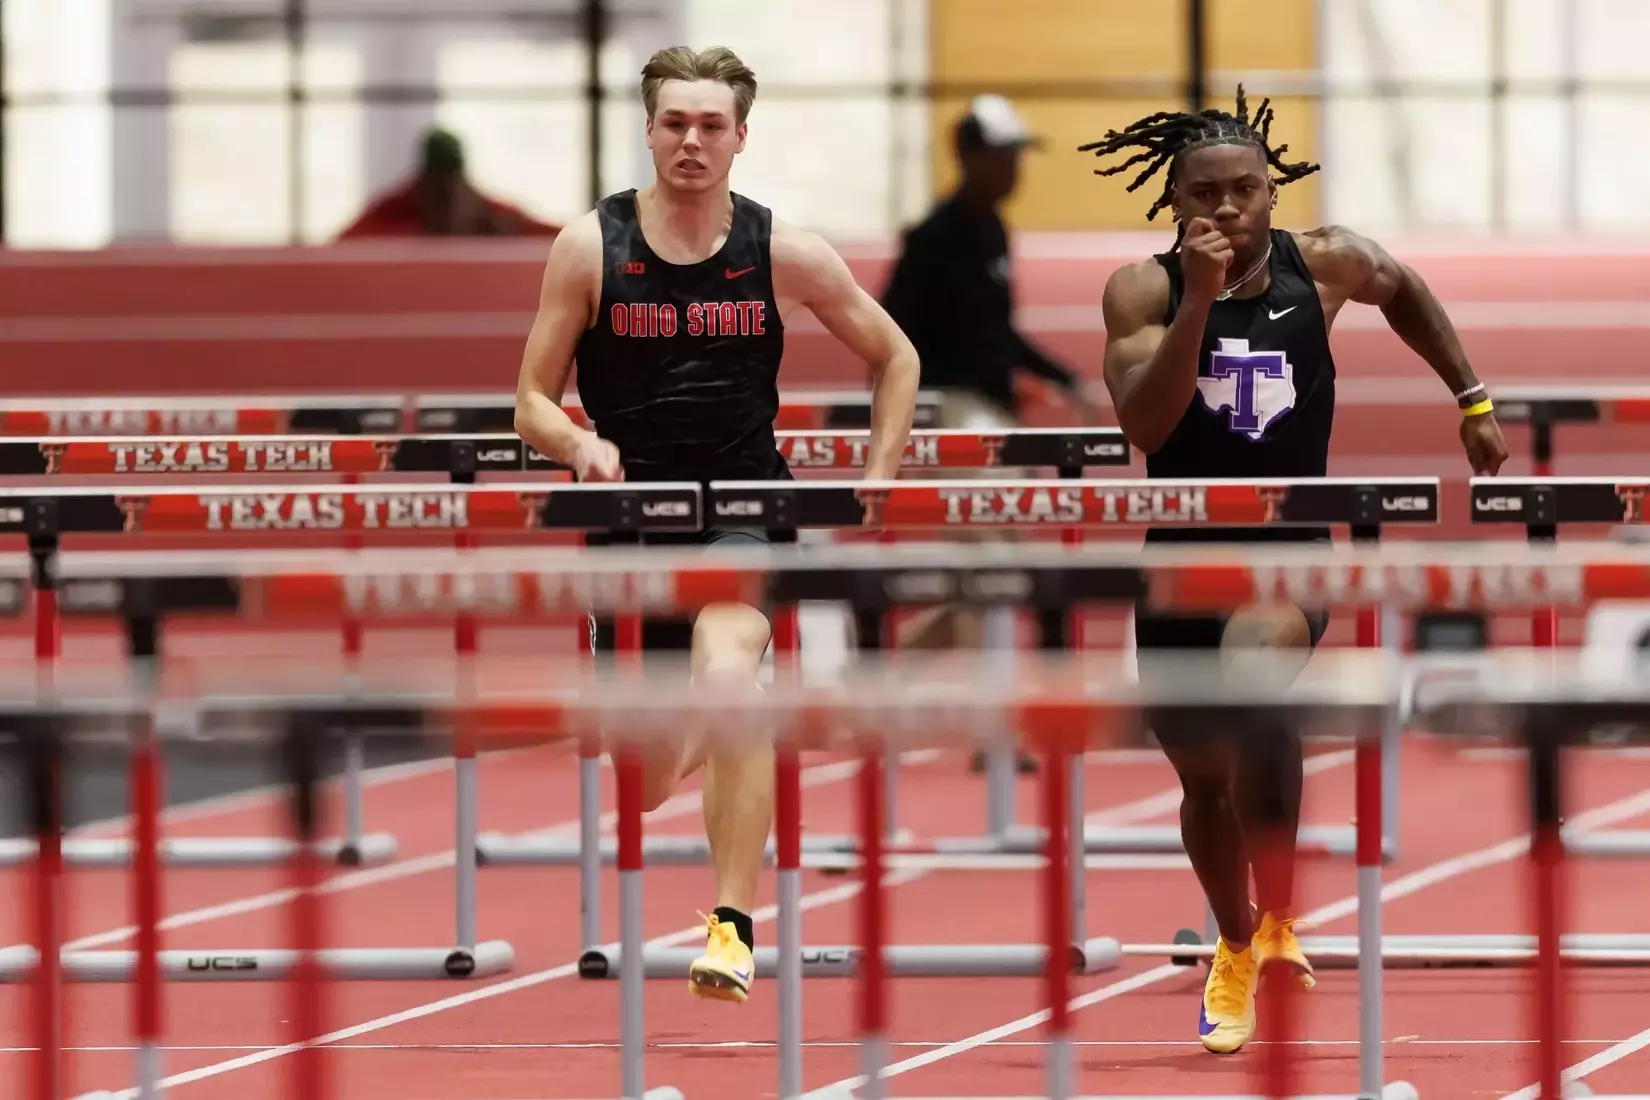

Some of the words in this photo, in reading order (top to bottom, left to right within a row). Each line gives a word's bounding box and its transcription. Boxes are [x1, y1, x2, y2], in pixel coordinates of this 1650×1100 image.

[611, 303, 677, 338] OHIO
[687, 301, 766, 336] STATE
[1210, 351, 1286, 432] T
[108, 441, 229, 472] TEXAS
[238, 441, 333, 471] TECH
[477, 449, 517, 462] UCS
[1084, 444, 1125, 456] UCS
[199, 493, 345, 530] TEXAS
[355, 491, 468, 528] TECH
[642, 502, 691, 517] UCS
[715, 500, 764, 516] UCS
[938, 487, 1083, 524] TEXAS
[1094, 485, 1208, 522] TECH
[1382, 496, 1429, 511] UCS
[1476, 496, 1523, 512] UCS
[187, 956, 258, 972] UCS
[801, 950, 862, 965] UC
